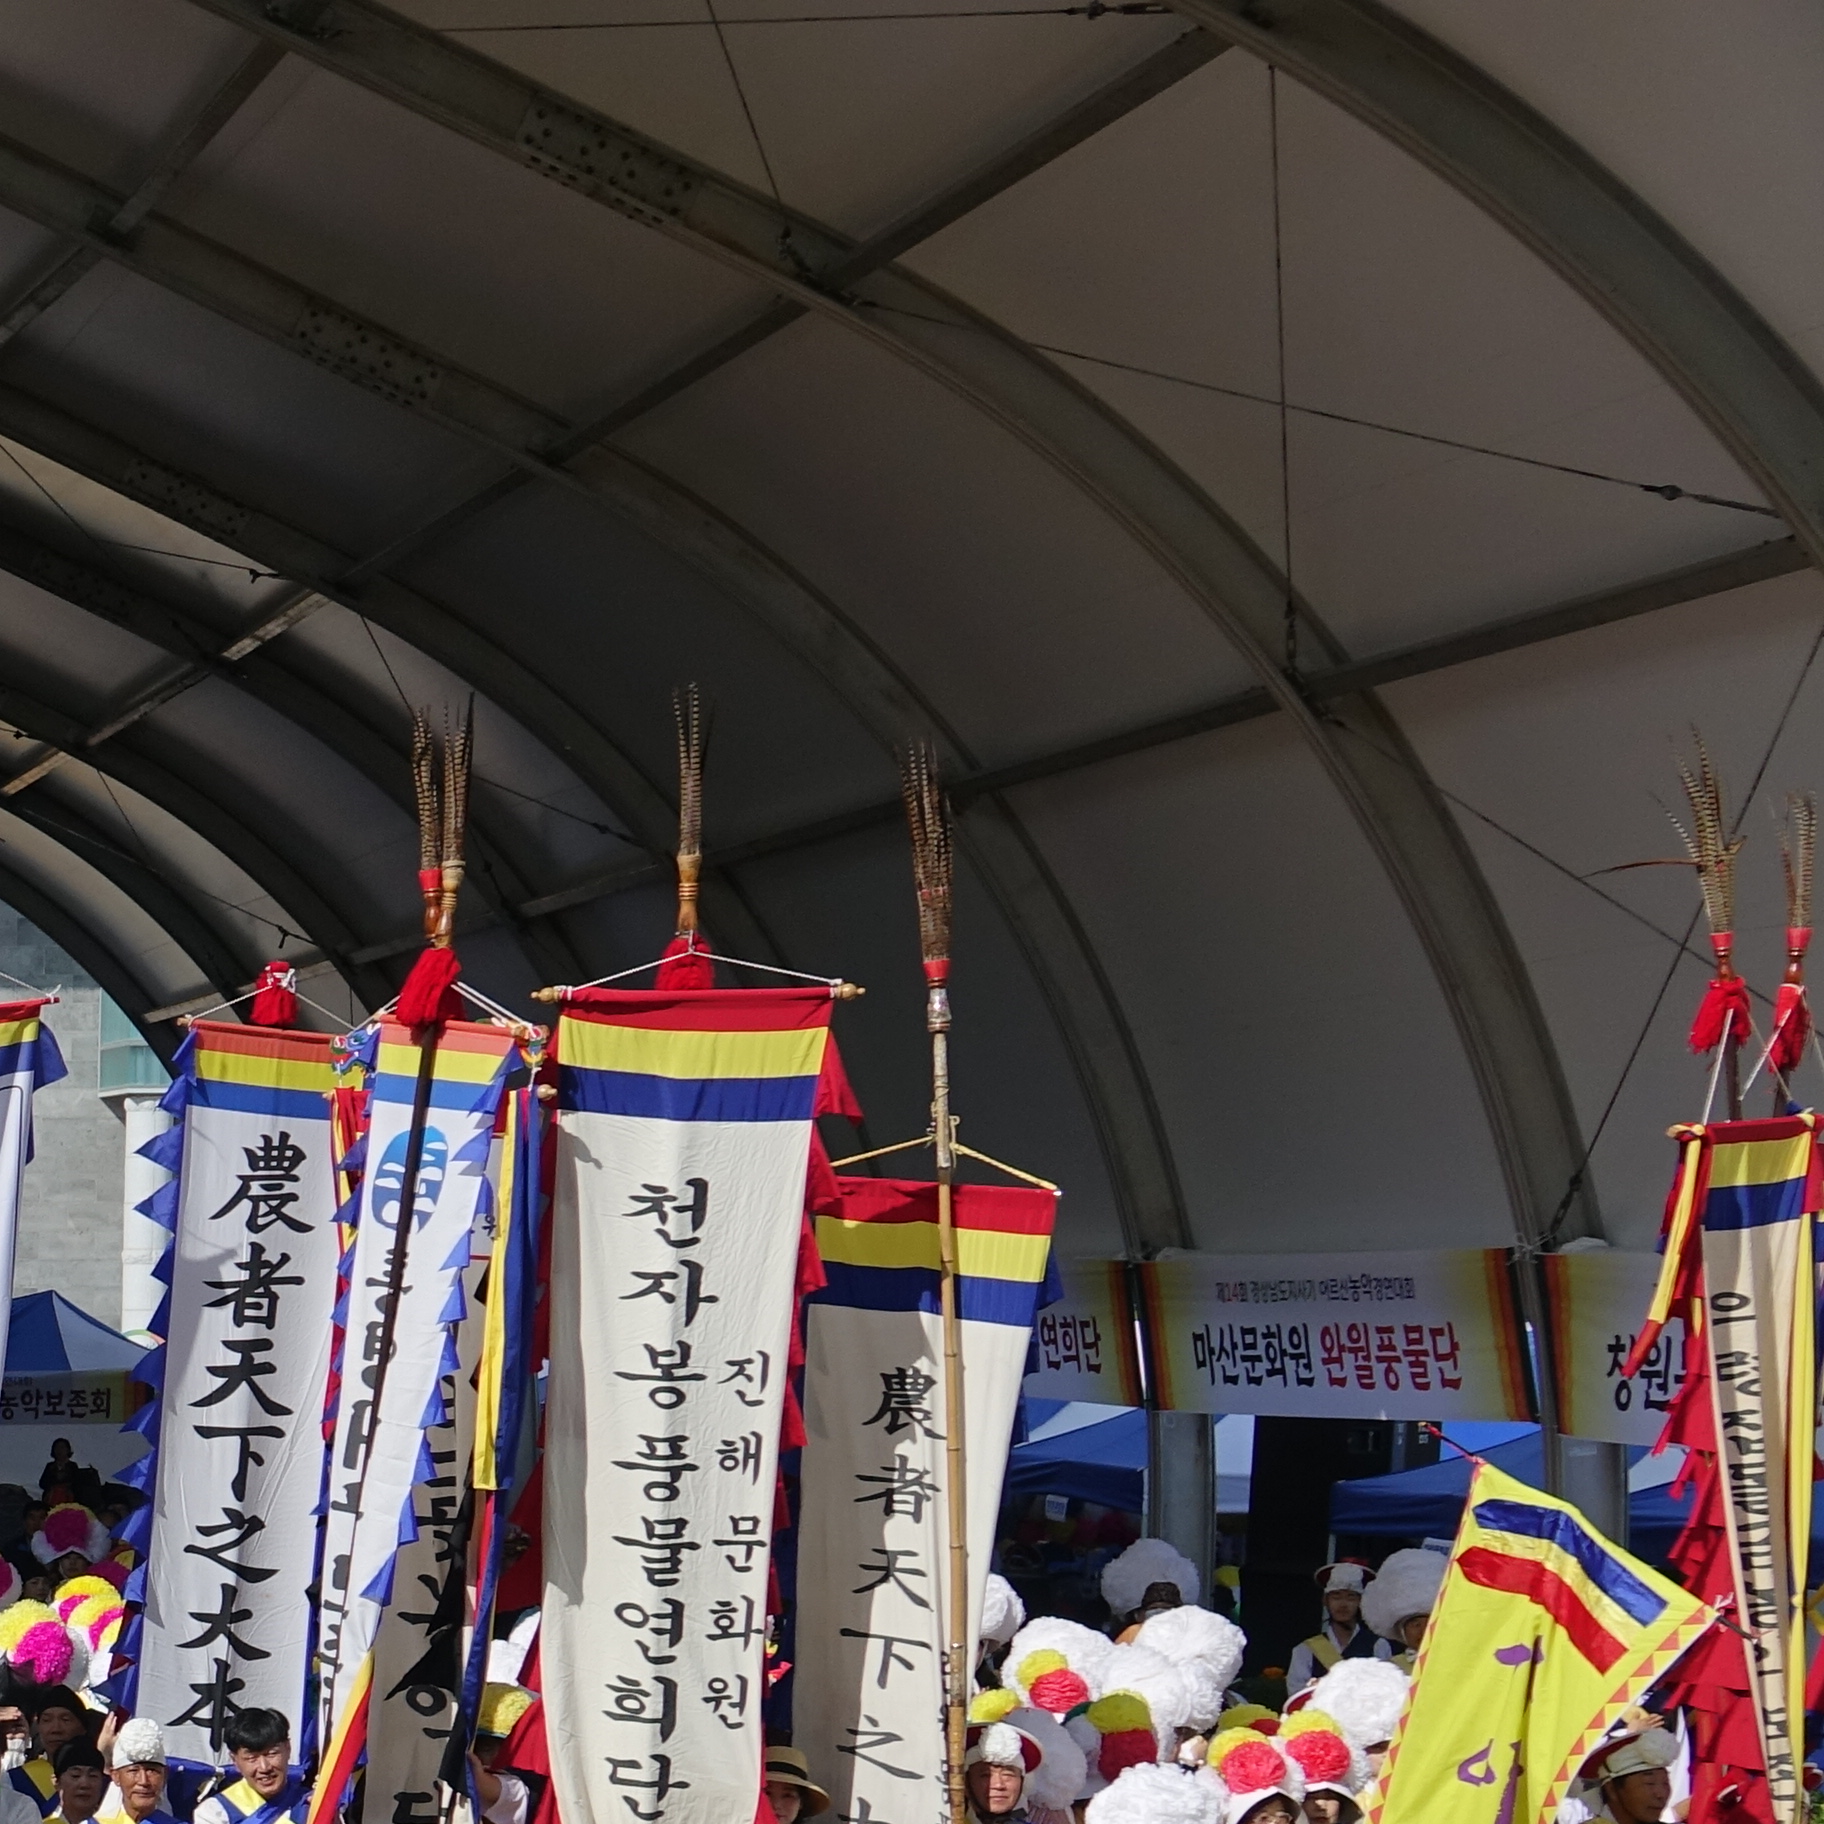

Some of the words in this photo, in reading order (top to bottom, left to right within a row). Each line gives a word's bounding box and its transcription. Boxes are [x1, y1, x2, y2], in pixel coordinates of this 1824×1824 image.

[167, 1129, 317, 1754] 農者天下之大本
[1192, 1321, 1315, 1388] 마산문화원
[1319, 1320, 1463, 1391] 완월풍물단
[1215, 1281, 1248, 1303] 제14회
[1249, 1279, 1316, 1304] 경상남도지사기
[1318, 1272, 1416, 1303] 어르신농악경연대회
[602, 1176, 720, 1822] 천자봉풍물연희단
[699, 1349, 769, 1732] 진해문화원
